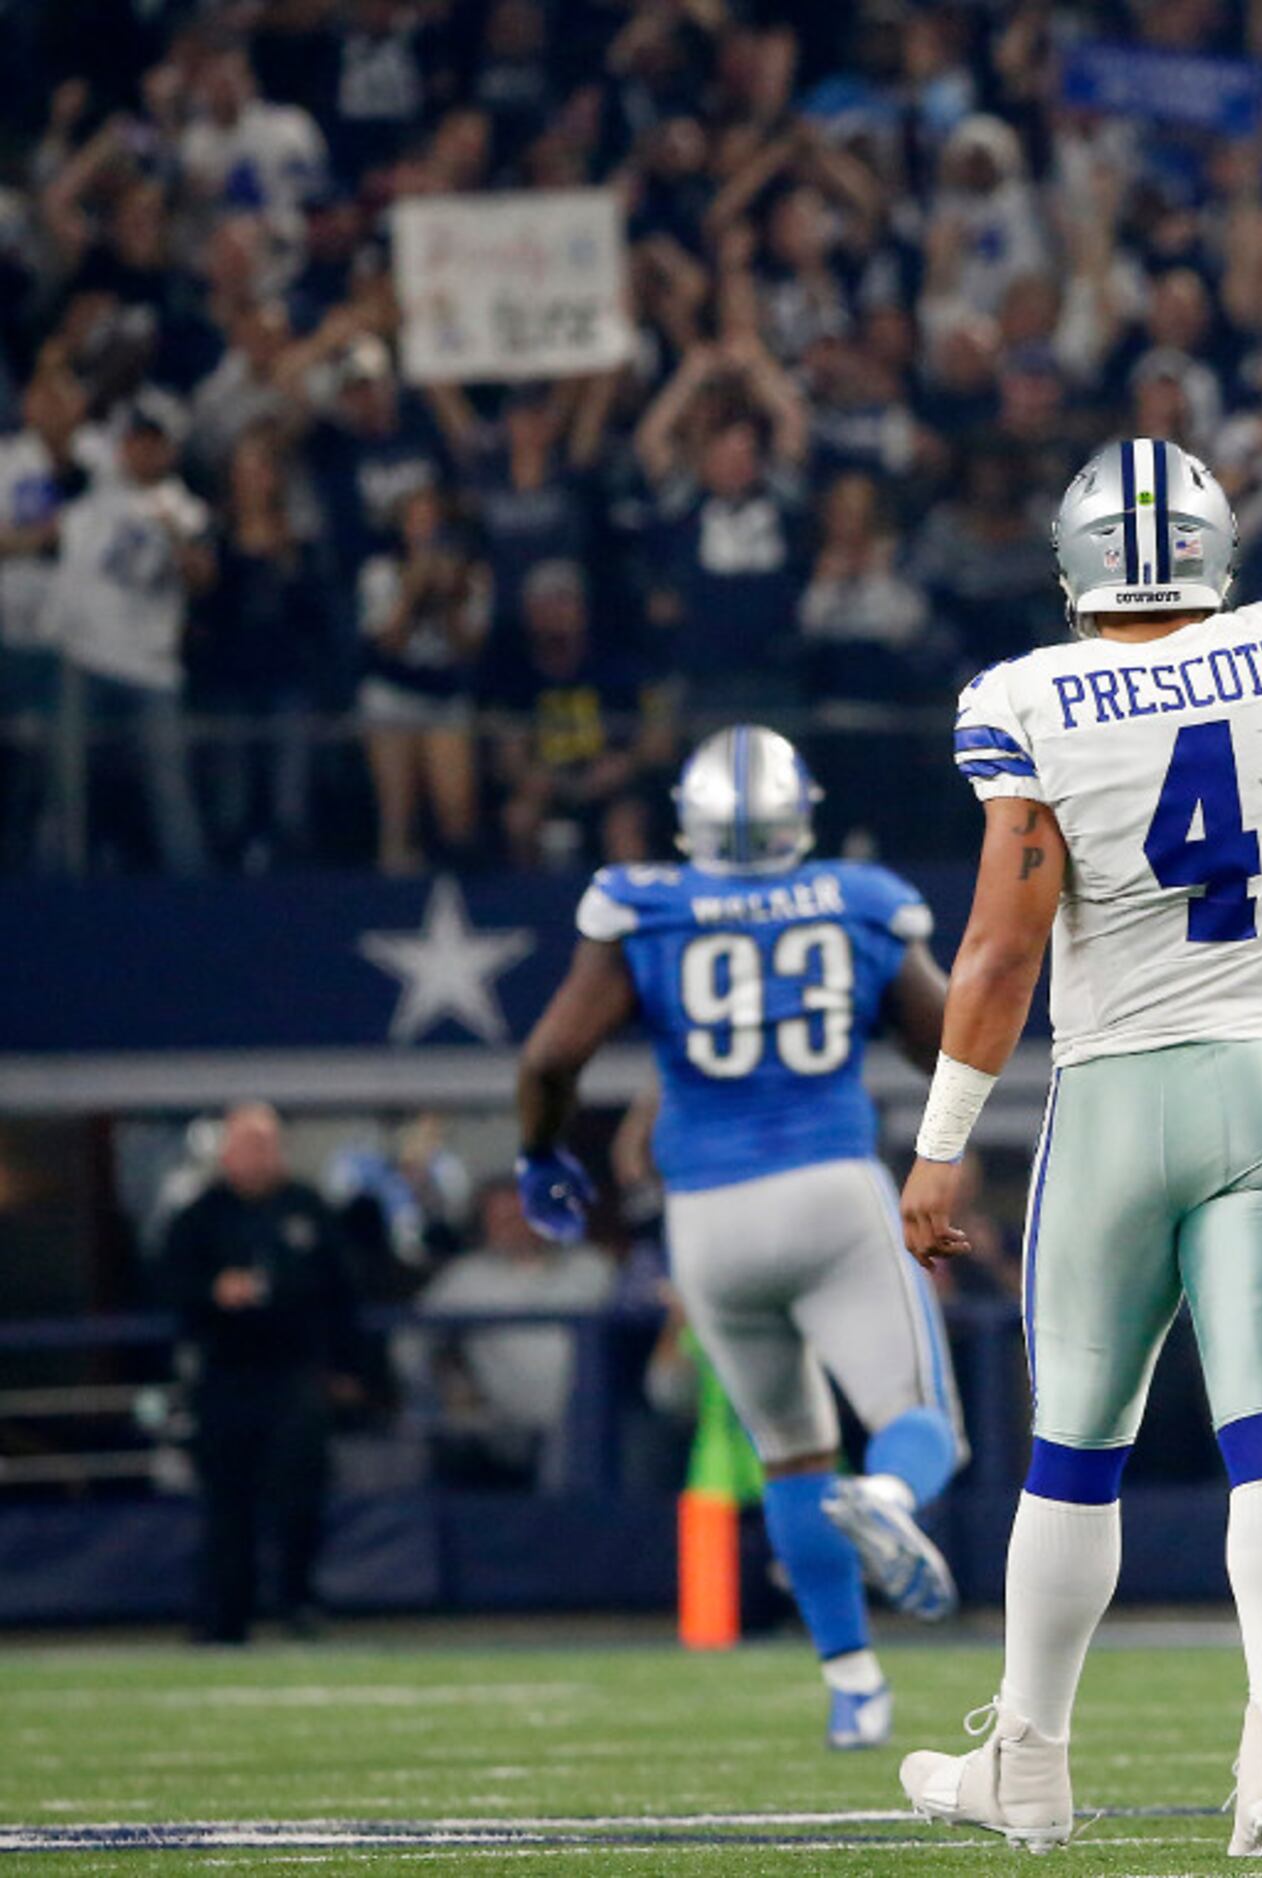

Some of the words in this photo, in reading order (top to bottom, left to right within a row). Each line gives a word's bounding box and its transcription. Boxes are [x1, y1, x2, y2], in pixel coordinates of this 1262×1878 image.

[1116, 591, 1181, 604] COWBOYS
[1019, 847, 1045, 879] P
[1142, 719, 1262, 942] 4
[682, 923, 855, 1079] 93
